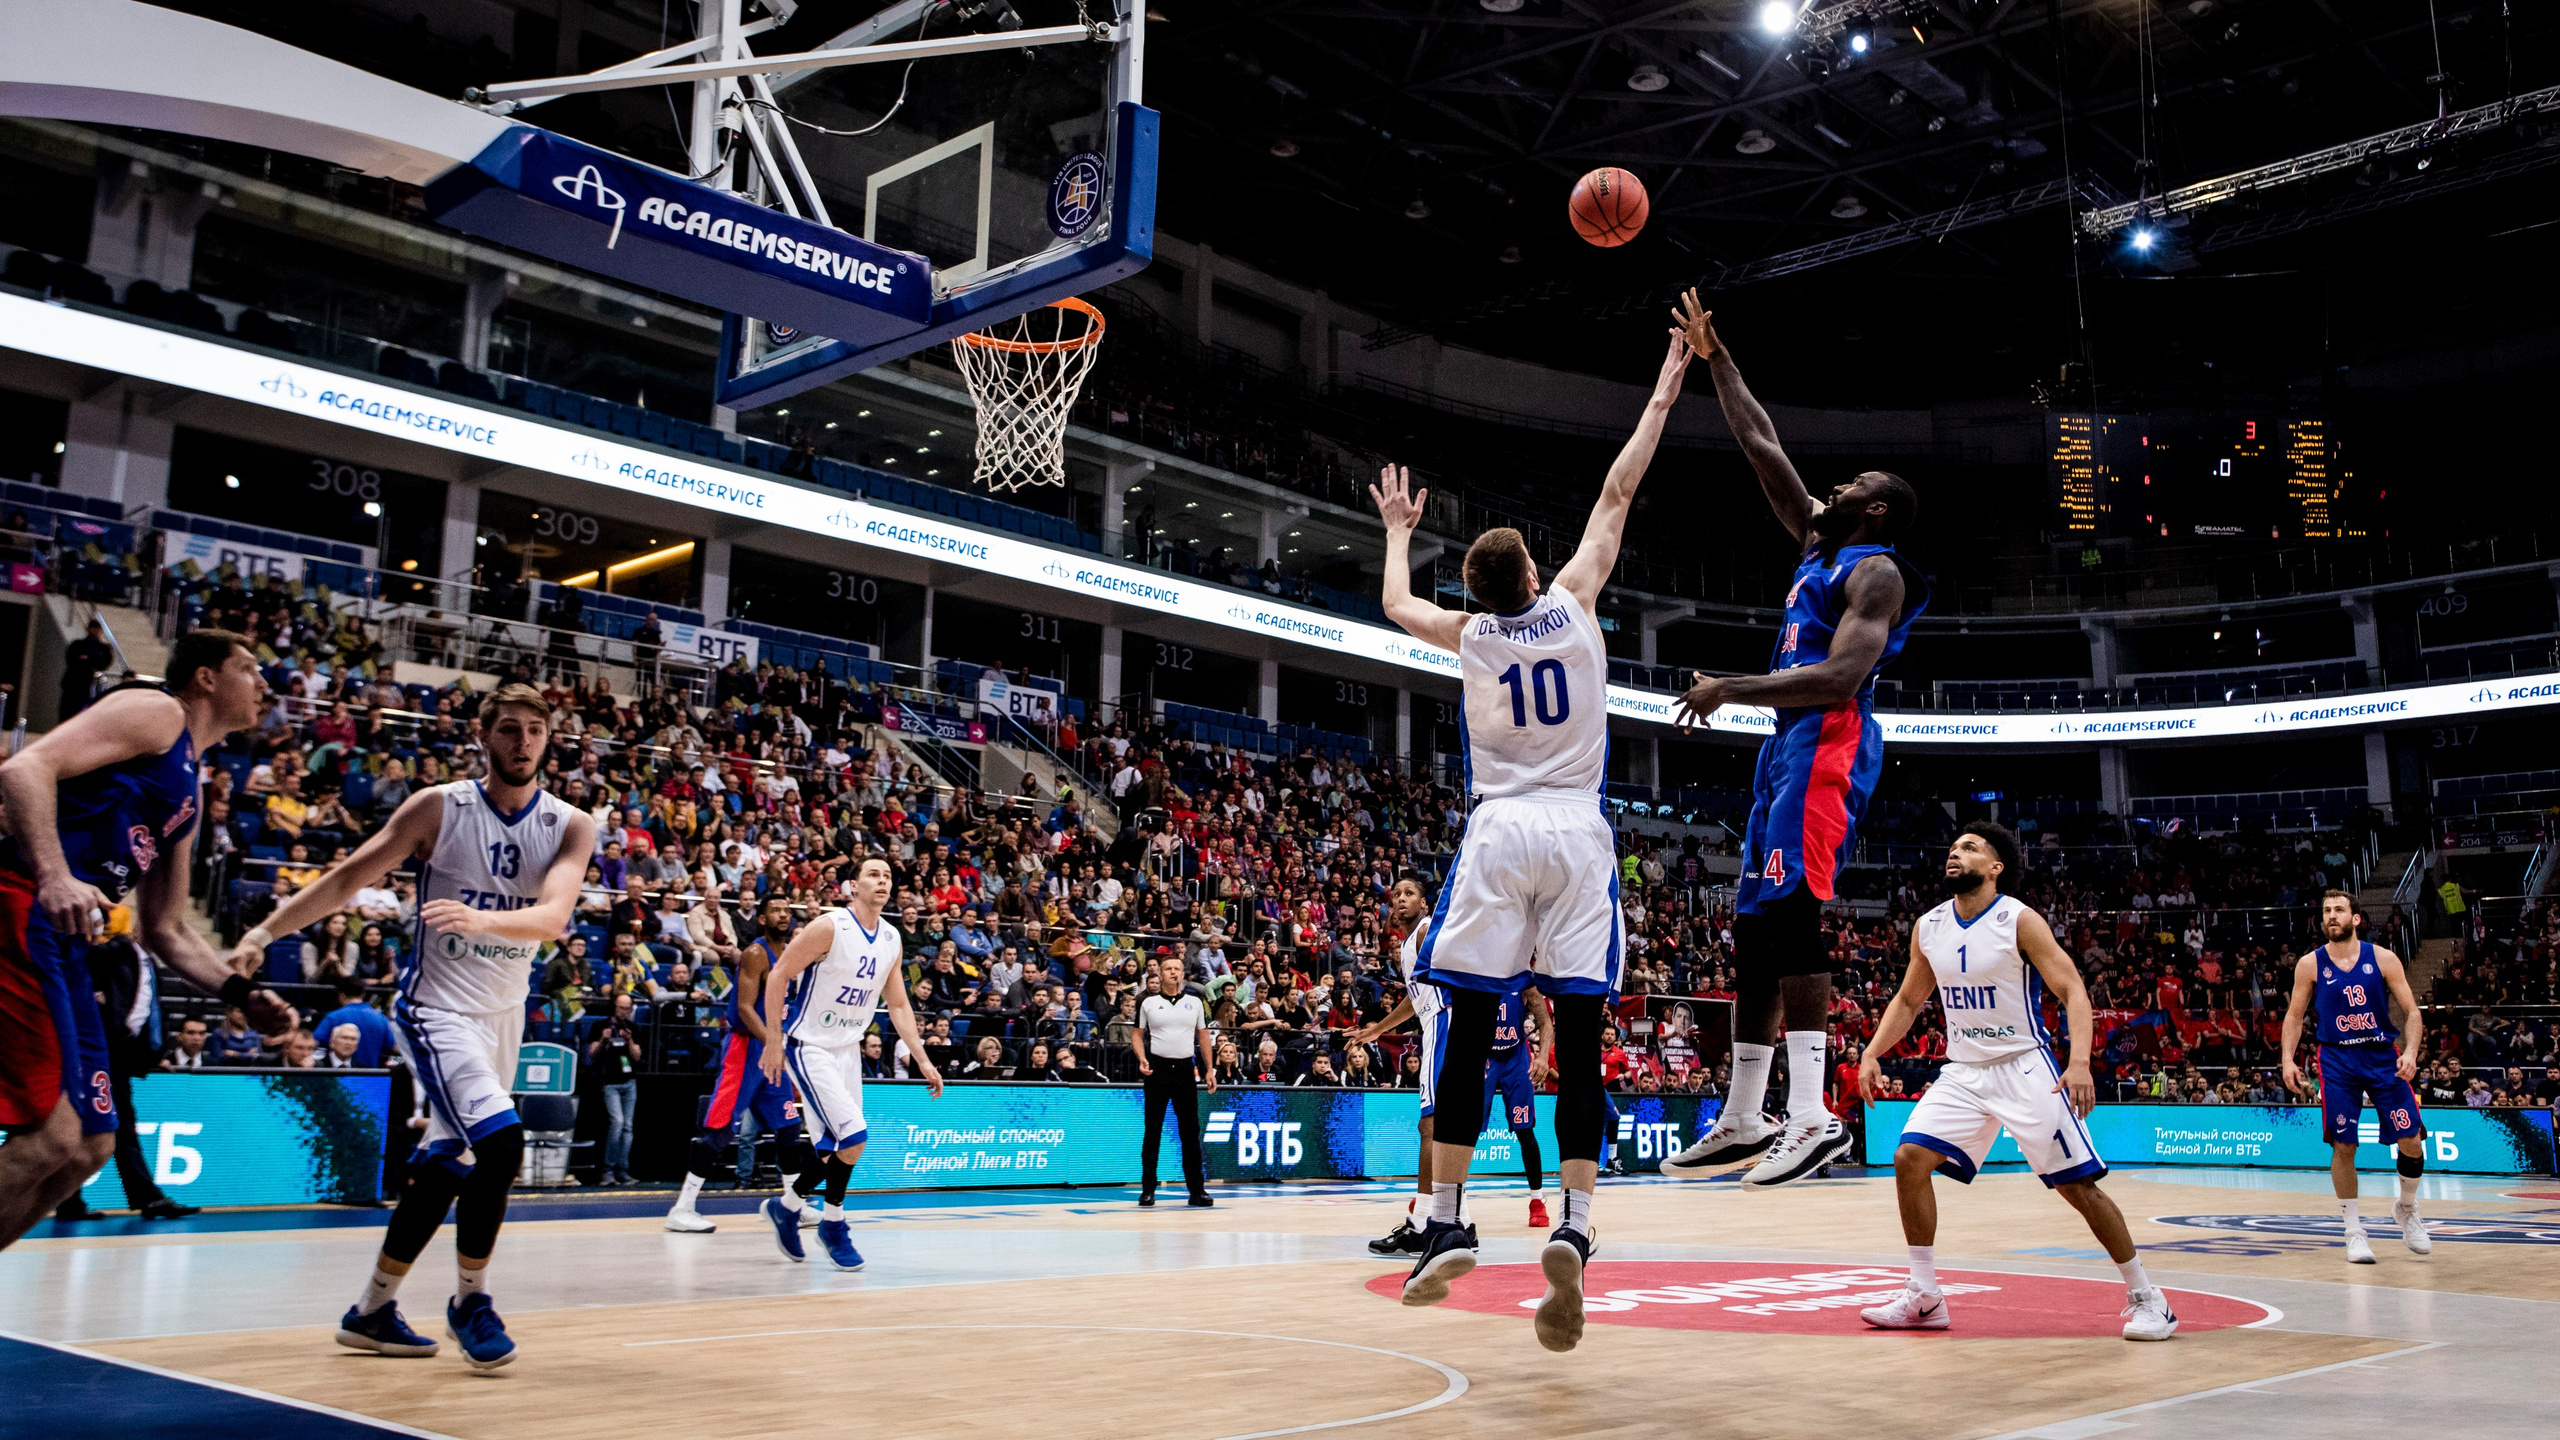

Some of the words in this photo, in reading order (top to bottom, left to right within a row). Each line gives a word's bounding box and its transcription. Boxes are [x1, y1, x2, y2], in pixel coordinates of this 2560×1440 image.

[1062, 153, 1083, 172] UNITED
[1084, 153, 1104, 169] LEAGUE
[1058, 225, 1075, 235] FINAL
[1076, 214, 1093, 232] FOUR
[309, 459, 381, 501] 308
[536, 506, 599, 545] 309
[827, 571, 878, 604] 310
[2420, 595, 2468, 617] 409
[1020, 612, 1061, 644] 311
[1155, 642, 1194, 671] 312
[1335, 681, 1368, 706] 313
[1498, 658, 1570, 728] 10
[936, 724, 956, 738] 203
[2431, 725, 2478, 748] 317
[2460, 837, 2481, 847] 204
[2497, 834, 2518, 845] 205
[489, 841, 521, 879] 13
[856, 956, 877, 980] 24
[1957, 944, 1967, 973] 1
[1942, 985, 1997, 1010] ZENIT
[2343, 985, 2367, 1007] 13
[1961, 1025, 2016, 1039] NIPIGAS
[91, 1070, 113, 1114] 3
[1513, 1106, 1529, 1123] 21
[2390, 1108, 2411, 1130] 13
[906, 1124, 995, 1149] Титульный
[999, 1128, 1065, 1147] спонсор
[1238, 1122, 1303, 1166] ВТБ
[1637, 1123, 1682, 1159] ВТБ
[2052, 1128, 2072, 1159] 1
[2155, 1127, 2218, 1141] Титульный
[2221, 1131, 2273, 1143] спонсор
[1489, 1145, 1511, 1160] ВТБ
[2155, 1142, 2201, 1155] Единой
[2203, 1143, 2232, 1155] Лиги
[2236, 1144, 2261, 1156] ВТБ
[903, 1151, 969, 1173] Единой
[972, 1151, 1011, 1170] Лиги
[1015, 1150, 1048, 1168] ВТБ
